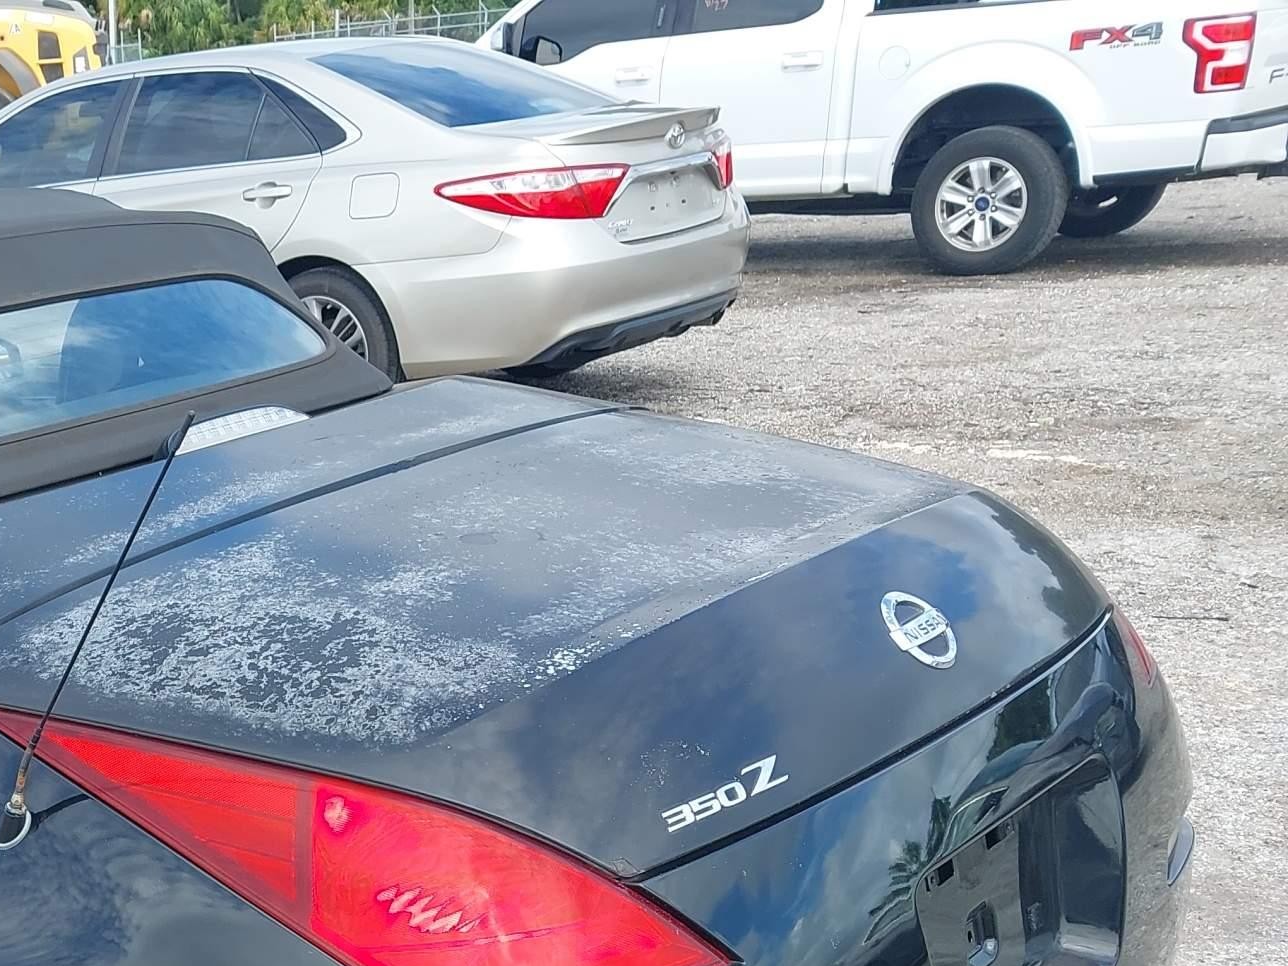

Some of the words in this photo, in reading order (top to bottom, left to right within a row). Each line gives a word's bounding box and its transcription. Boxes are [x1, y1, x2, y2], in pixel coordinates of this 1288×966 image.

[1069, 22, 1163, 51] FX4
[1269, 67, 1288, 84] F
[661, 753, 790, 833] 350Z
